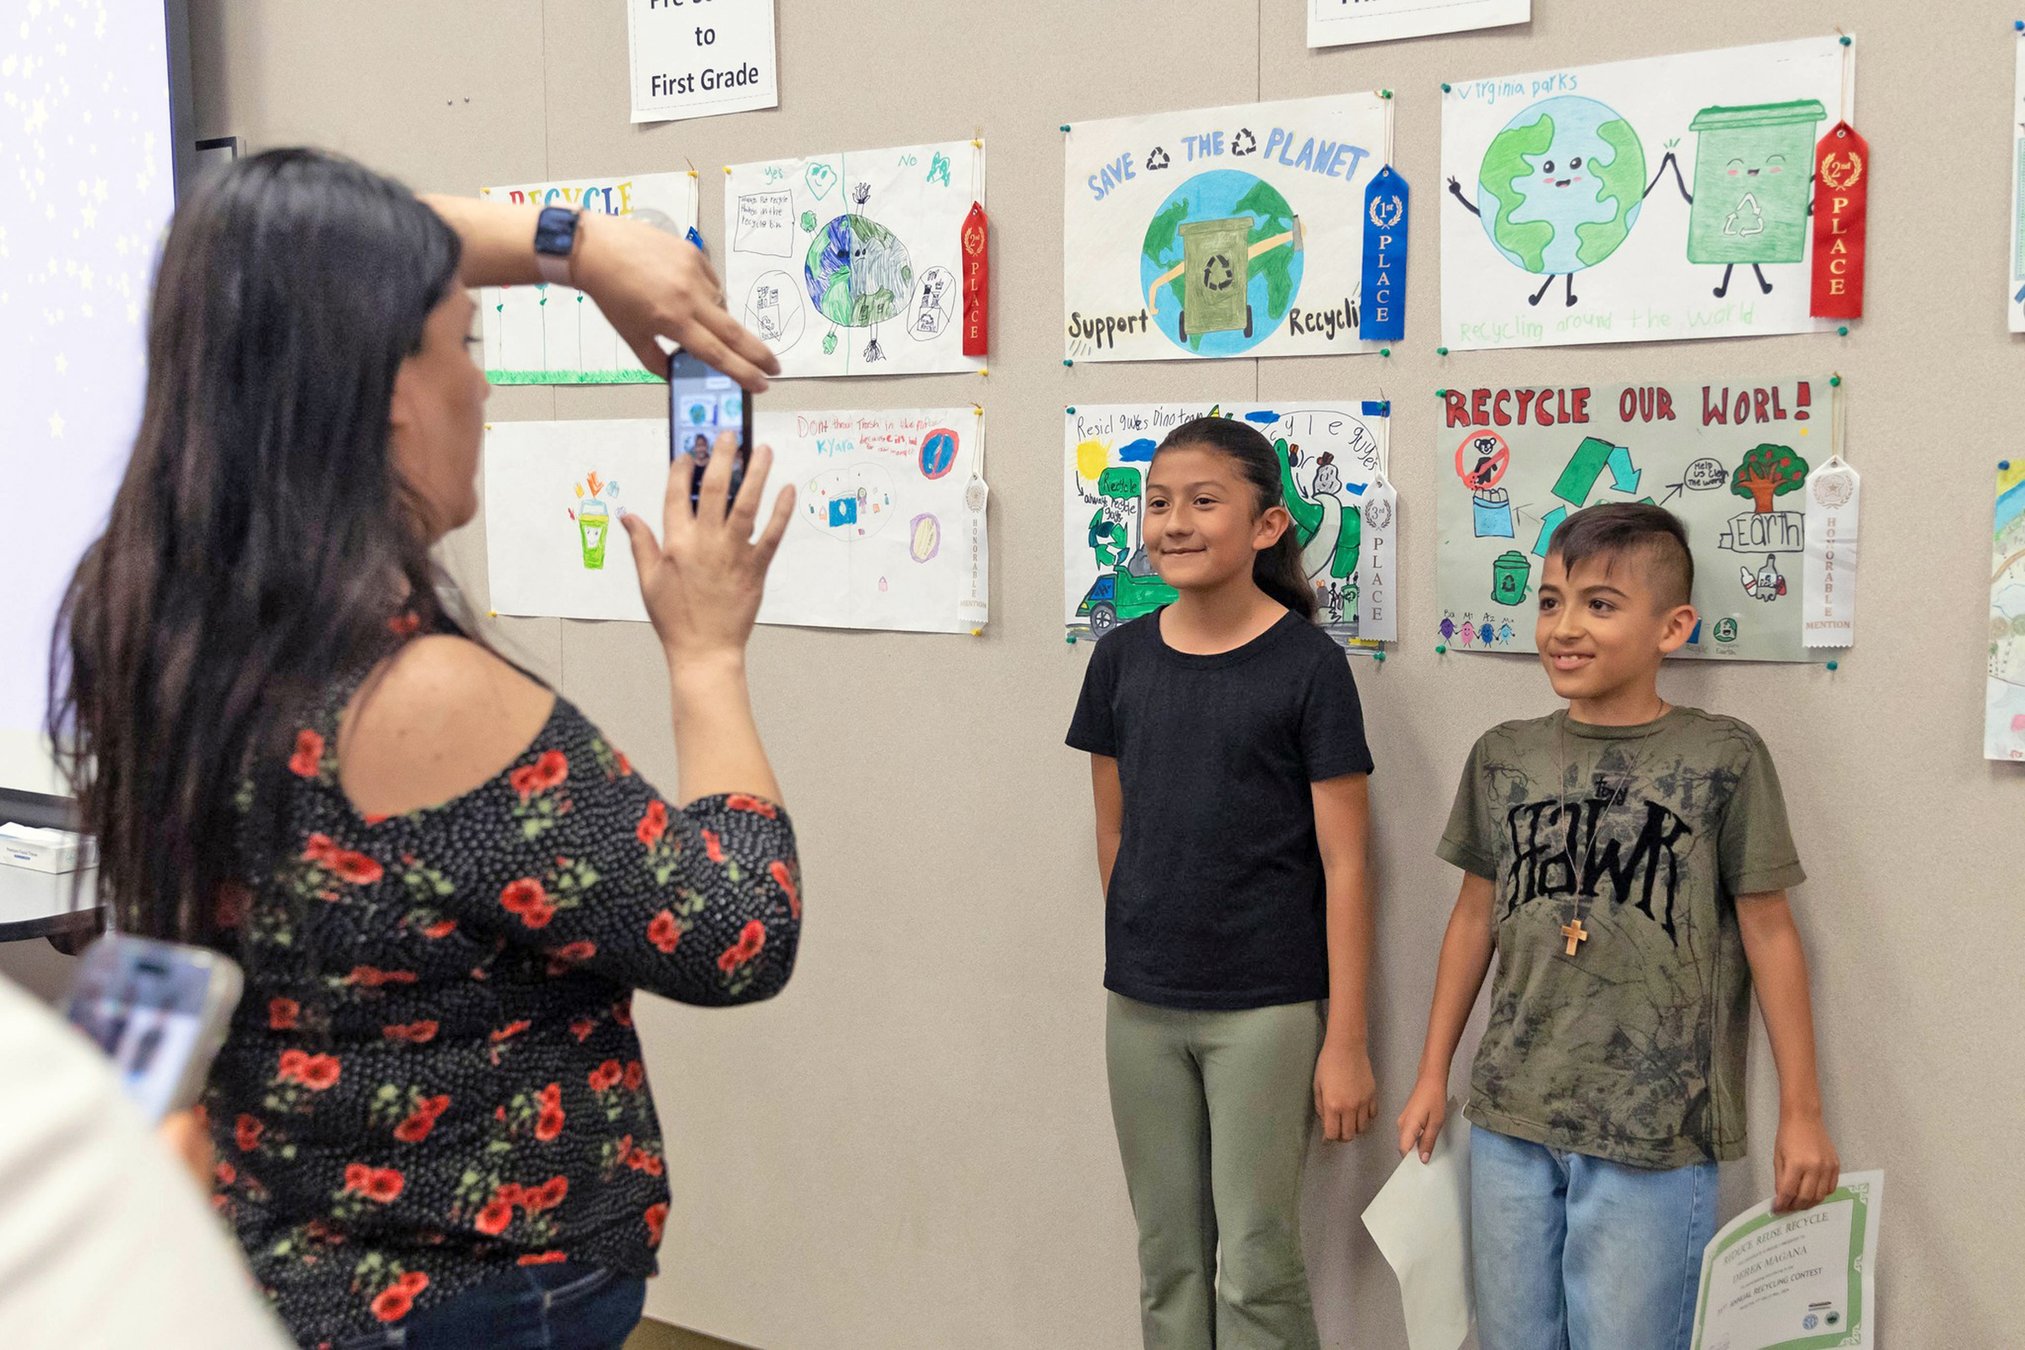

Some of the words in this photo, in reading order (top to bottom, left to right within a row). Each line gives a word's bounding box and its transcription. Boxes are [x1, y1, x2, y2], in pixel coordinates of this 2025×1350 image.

[695, 26, 716, 46] to
[651, 73, 695, 97] First
[700, 62, 759, 90] Grade
[1532, 73, 1578, 98] parks
[1088, 152, 1137, 201] SAVE
[1181, 131, 1225, 162] THE
[1264, 127, 1371, 182] PLANET
[1831, 160, 1852, 178] 2nd
[1379, 201, 1394, 219] 1st
[1828, 198, 1849, 296] PLACE
[1376, 235, 1393, 323] PLACE
[971, 262, 980, 339] PLACE
[1068, 308, 1149, 349] Support
[1289, 298, 1361, 341] Recycli
[1630, 308, 1671, 329] the
[1444, 387, 1591, 428] RECYCLE
[1619, 386, 1676, 423] OUR
[1371, 506, 1385, 520] 3rd
[1372, 537, 1384, 621] PLACE
[959, 600, 987, 609] MENTION
[1806, 620, 1850, 630] MENTION
[1790, 1267, 1823, 1282] CONTEST
